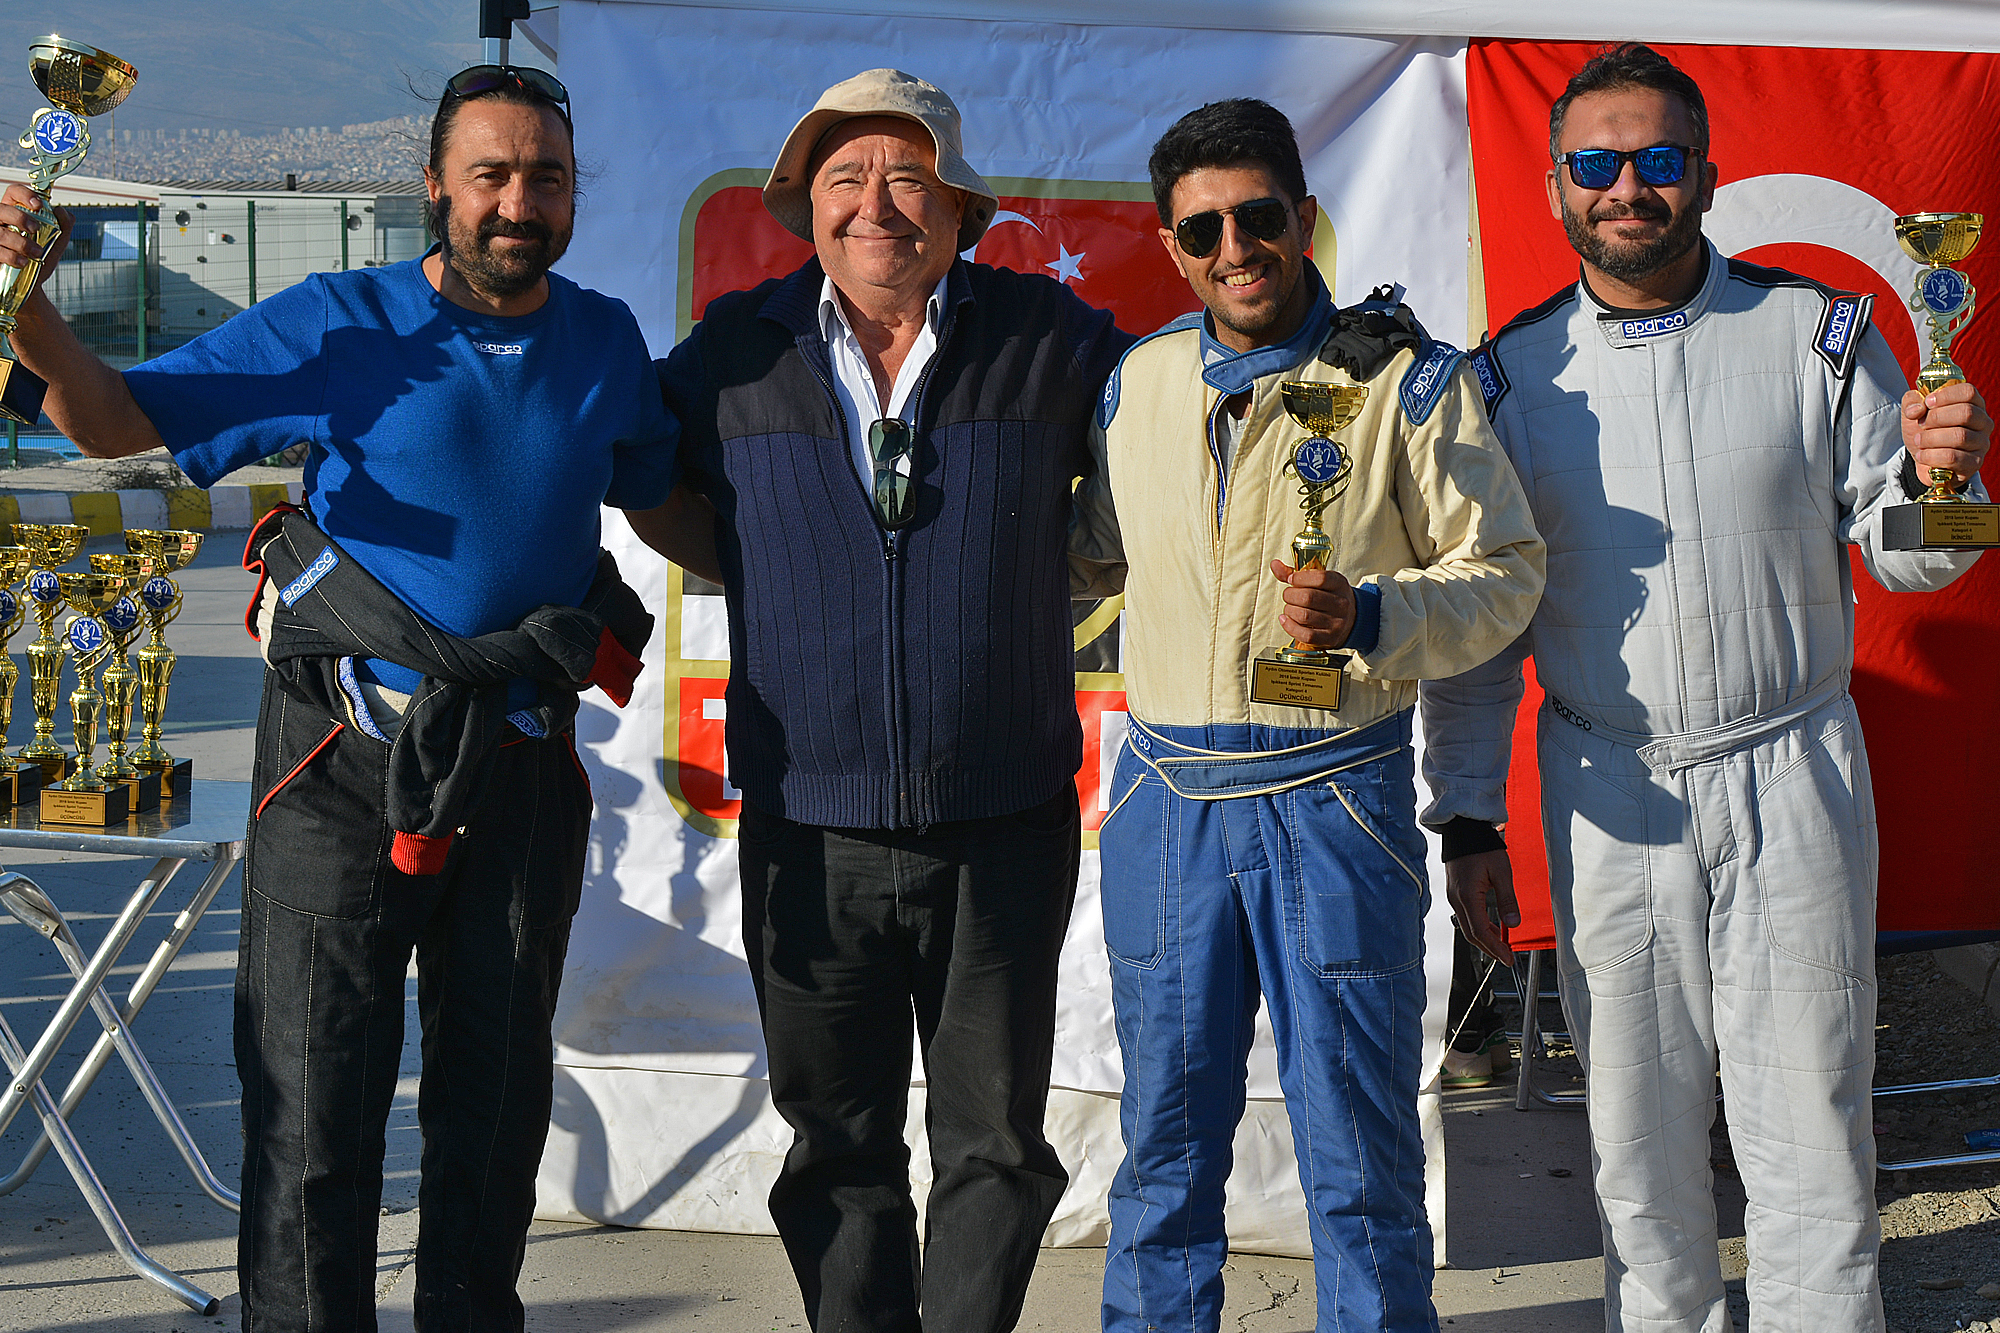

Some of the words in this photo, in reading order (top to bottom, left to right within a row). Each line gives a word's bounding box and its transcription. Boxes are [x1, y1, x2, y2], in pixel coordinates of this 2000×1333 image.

[1625, 315, 1686, 338] sparco
[1825, 302, 1854, 352] sparco
[472, 341, 522, 355] sparco
[1412, 345, 1453, 399] sparco
[1471, 354, 1497, 401] sparco
[283, 553, 336, 605] sparco
[1279, 693, 1312, 702] ÜÇÜNCÜSÜ
[1552, 695, 1592, 731] sparco
